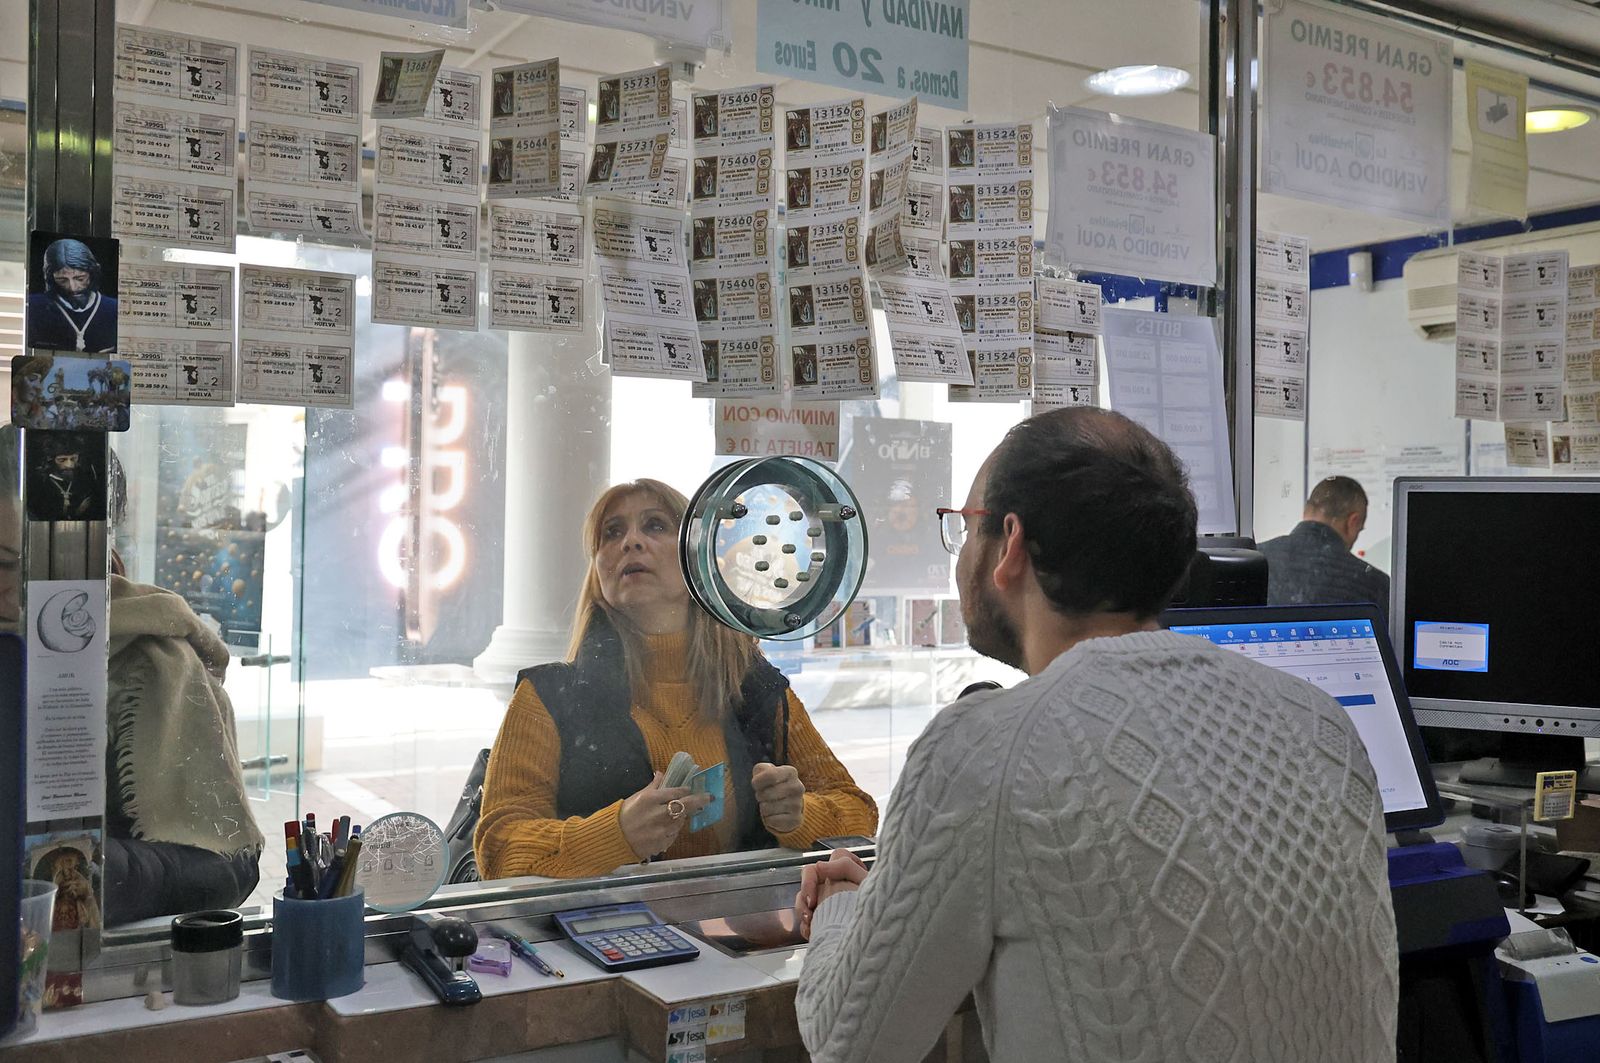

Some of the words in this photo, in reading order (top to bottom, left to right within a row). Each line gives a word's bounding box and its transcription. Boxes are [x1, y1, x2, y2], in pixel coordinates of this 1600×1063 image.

[516, 69, 548, 85] 45644
[623, 75, 656, 89] 55731
[214, 81, 222, 91] 2
[192, 93, 216, 101] HUELVA
[341, 94, 348, 104] 2
[720, 93, 757, 105] 75460
[463, 102, 470, 111] 2
[814, 106, 850, 118] 13156
[977, 130, 1016, 140] 81524
[516, 137, 548, 150] 45644
[620, 140, 653, 152] 55731
[214, 151, 221, 161] 2
[720, 155, 756, 166] 75460
[191, 164, 215, 172] HUELVA
[341, 163, 348, 172] 2
[462, 167, 469, 175] 2
[815, 166, 850, 178] 13156
[977, 185, 1016, 195] 81524
[213, 221, 220, 231] 2
[718, 215, 753, 228] 75460
[812, 225, 844, 236] 13156
[461, 232, 467, 240] 2
[568, 245, 575, 253] 2
[977, 240, 1016, 250] 81524
[719, 278, 755, 290] 75460
[815, 284, 849, 296] 13156
[460, 296, 467, 304] 2
[978, 296, 1016, 306] 81524
[210, 306, 217, 315] 2
[334, 307, 342, 317] 2
[721, 341, 758, 352] 75460
[820, 344, 856, 354] 13156
[978, 352, 1015, 361] 81524
[211, 376, 218, 386] 2
[334, 376, 341, 384] 2
[727, 1000, 745, 1016] fesa
[687, 1007, 705, 1022] fesa
[686, 1031, 705, 1045] fesa
[687, 1052, 704, 1063] fesa
